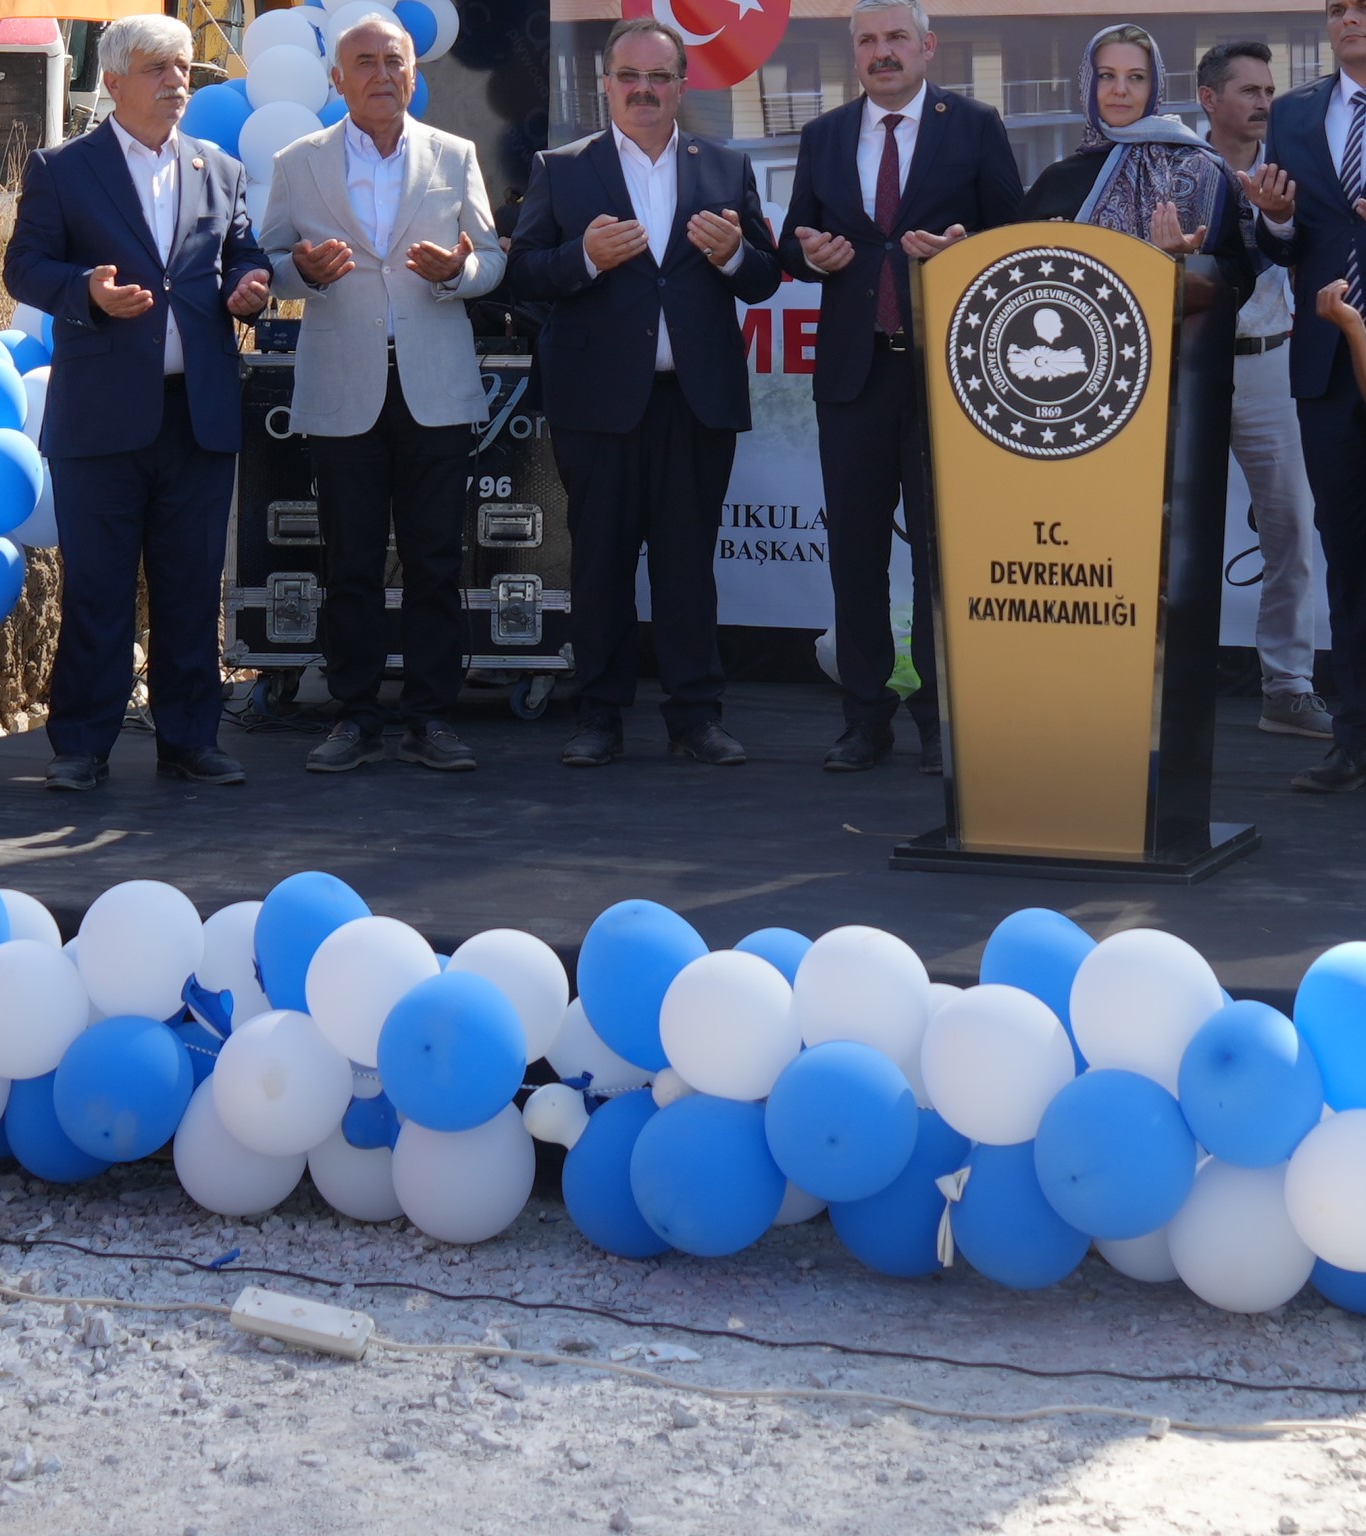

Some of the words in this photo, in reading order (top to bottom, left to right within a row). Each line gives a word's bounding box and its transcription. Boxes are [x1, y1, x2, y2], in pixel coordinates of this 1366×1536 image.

[987, 289, 1035, 349] CUMHURİYETİ
[1035, 289, 1093, 317] DEVREKANİ
[1086, 312, 1110, 397] KAYMAKAMLIĞI
[986, 350, 1010, 396] TÜRKİYE
[1035, 406, 1062, 418] 1869
[1033, 521, 1069, 546] T.C.
[990, 557, 1113, 588] DEVREKANİ
[969, 594, 1136, 627] KAYMAKAMLIĞI
